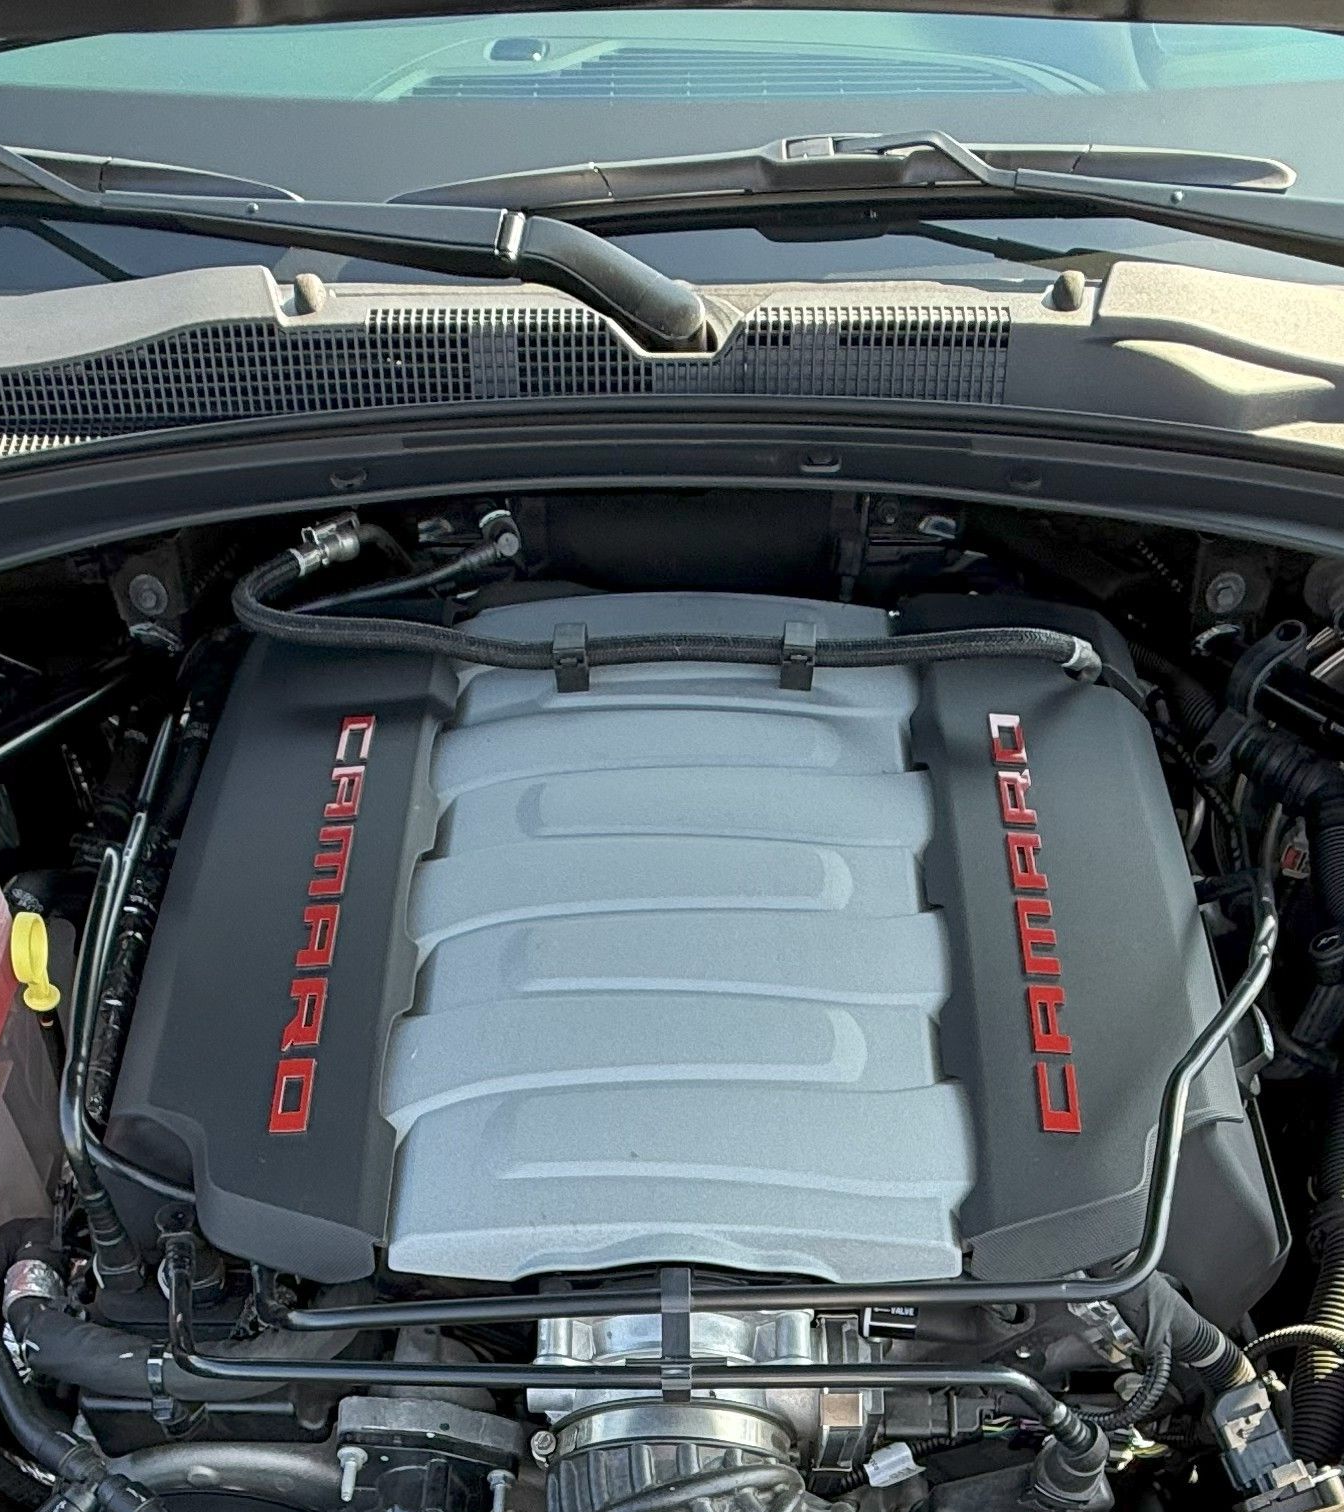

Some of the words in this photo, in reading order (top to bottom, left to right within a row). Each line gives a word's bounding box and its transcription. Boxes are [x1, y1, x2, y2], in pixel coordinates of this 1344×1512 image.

[268, 715, 376, 1134] CAMARO
[988, 712, 1083, 1134] CAMARO
[890, 1306, 915, 1317] VALVE
